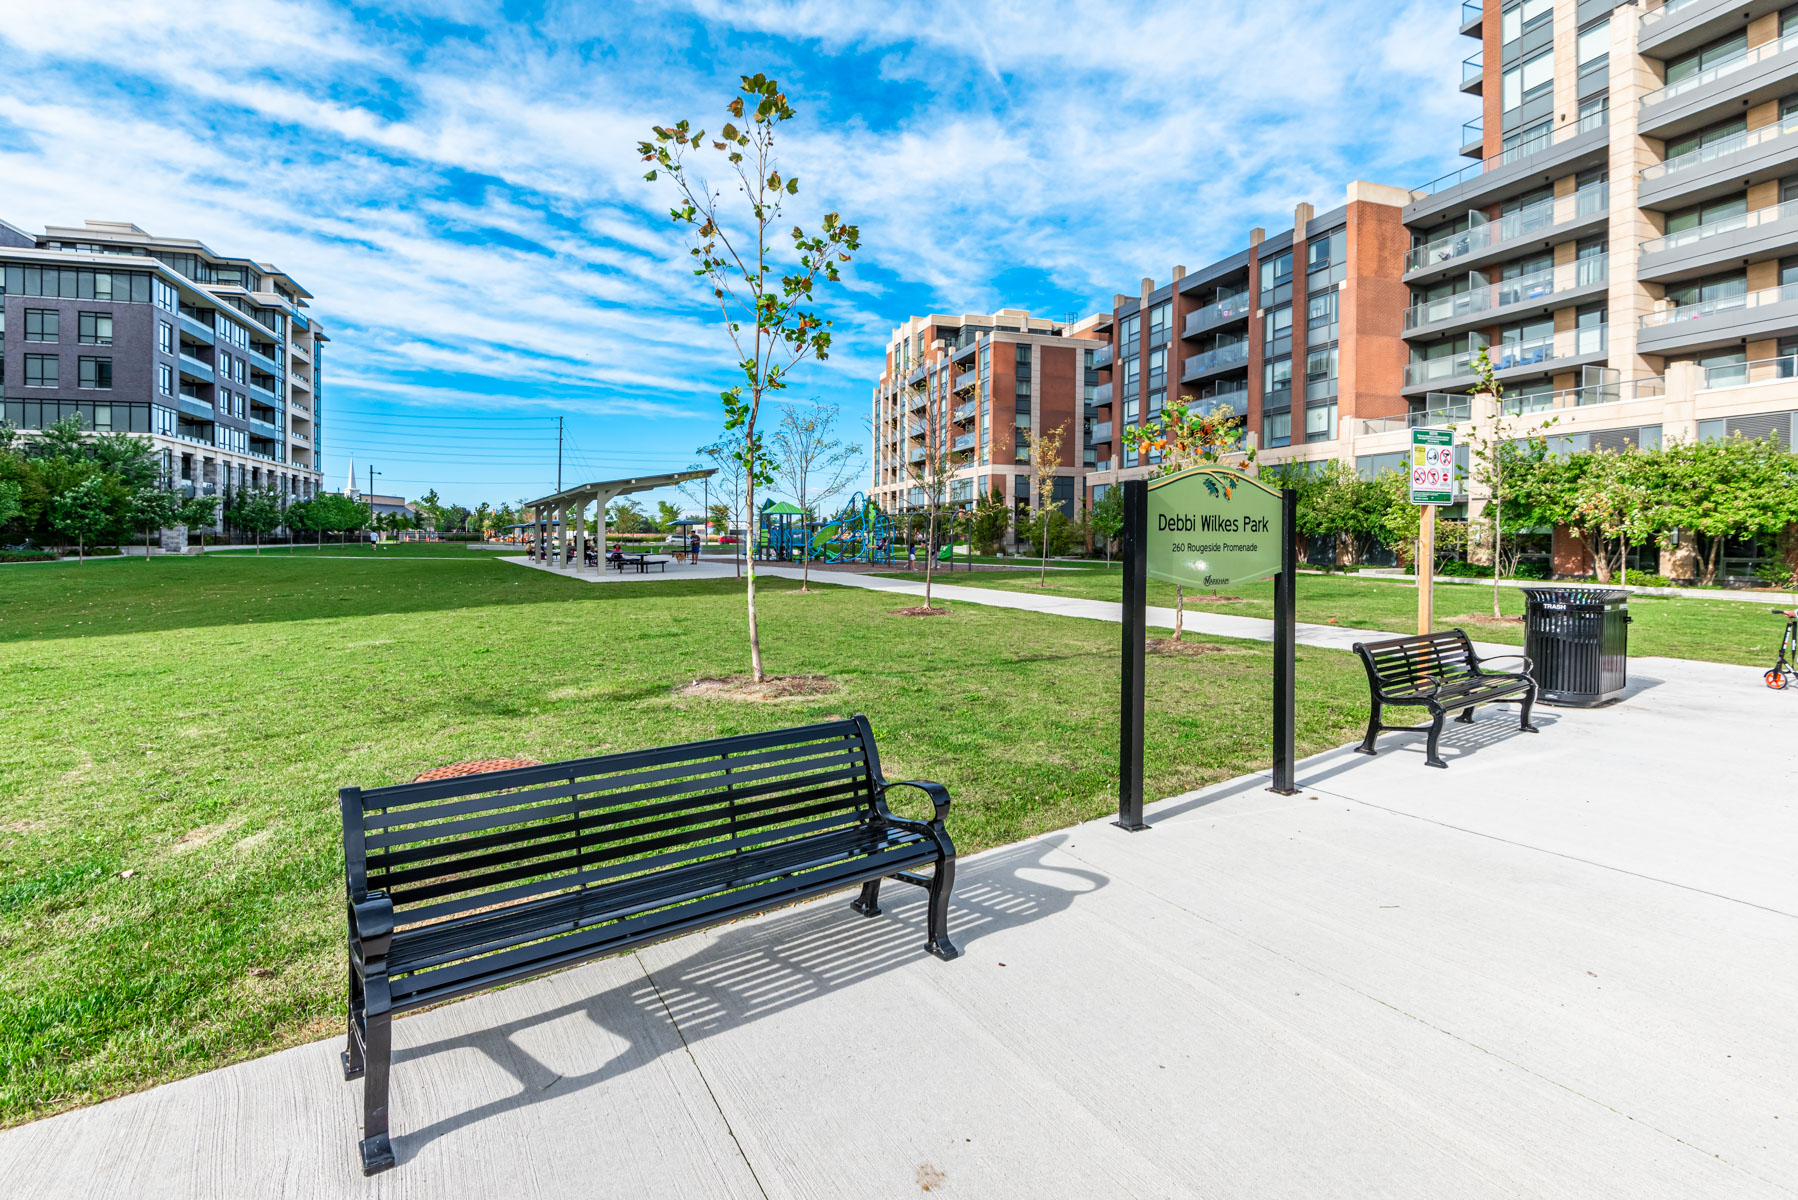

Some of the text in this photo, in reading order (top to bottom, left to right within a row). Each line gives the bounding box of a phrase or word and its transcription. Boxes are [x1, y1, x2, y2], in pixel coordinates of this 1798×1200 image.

[1158, 514, 1269, 533] Debbi Wilkes Park
[1172, 543, 1258, 554] 260 Rougeside Promenade
[1203, 575, 1229, 586] MARKHAM
